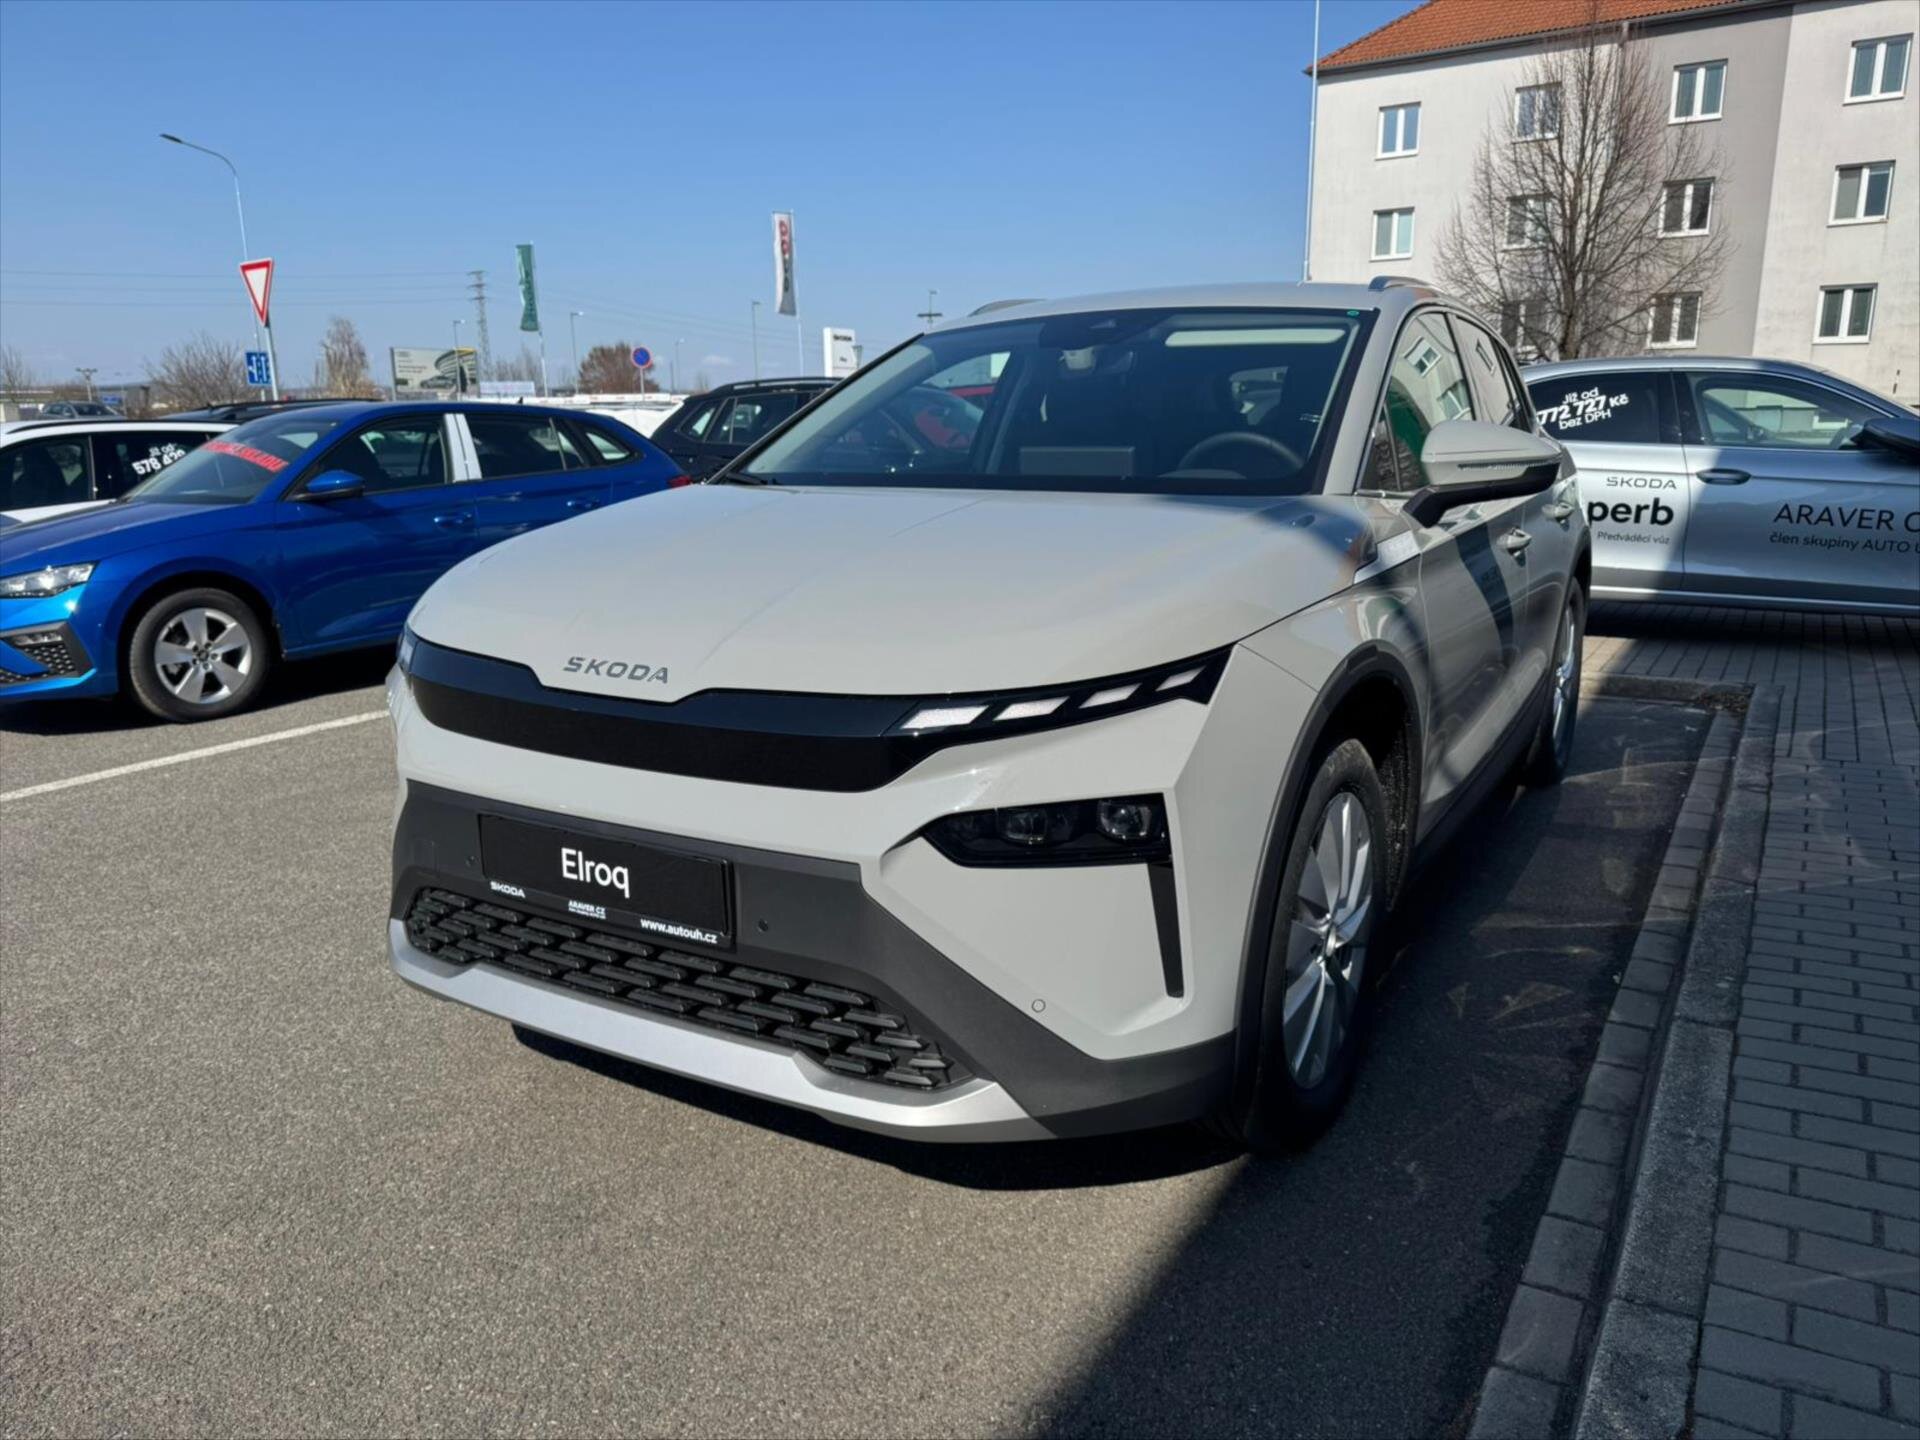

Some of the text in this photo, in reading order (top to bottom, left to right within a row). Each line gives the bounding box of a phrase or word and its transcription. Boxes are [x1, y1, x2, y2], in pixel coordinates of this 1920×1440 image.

[1562, 387, 1599, 404] Již od
[1573, 395, 1606, 416] 727
[1609, 393, 1629, 407] Kč
[1559, 408, 1612, 430] bez DPH
[131, 457, 162, 475] 578
[1773, 503, 1895, 531] ARAVER
[1769, 531, 1799, 544] člen
[1803, 535, 1859, 550] skupiny
[1863, 539, 1911, 553] AUTO
[561, 847, 630, 899] Elroq
[640, 918, 718, 944] www.autouh.cz
